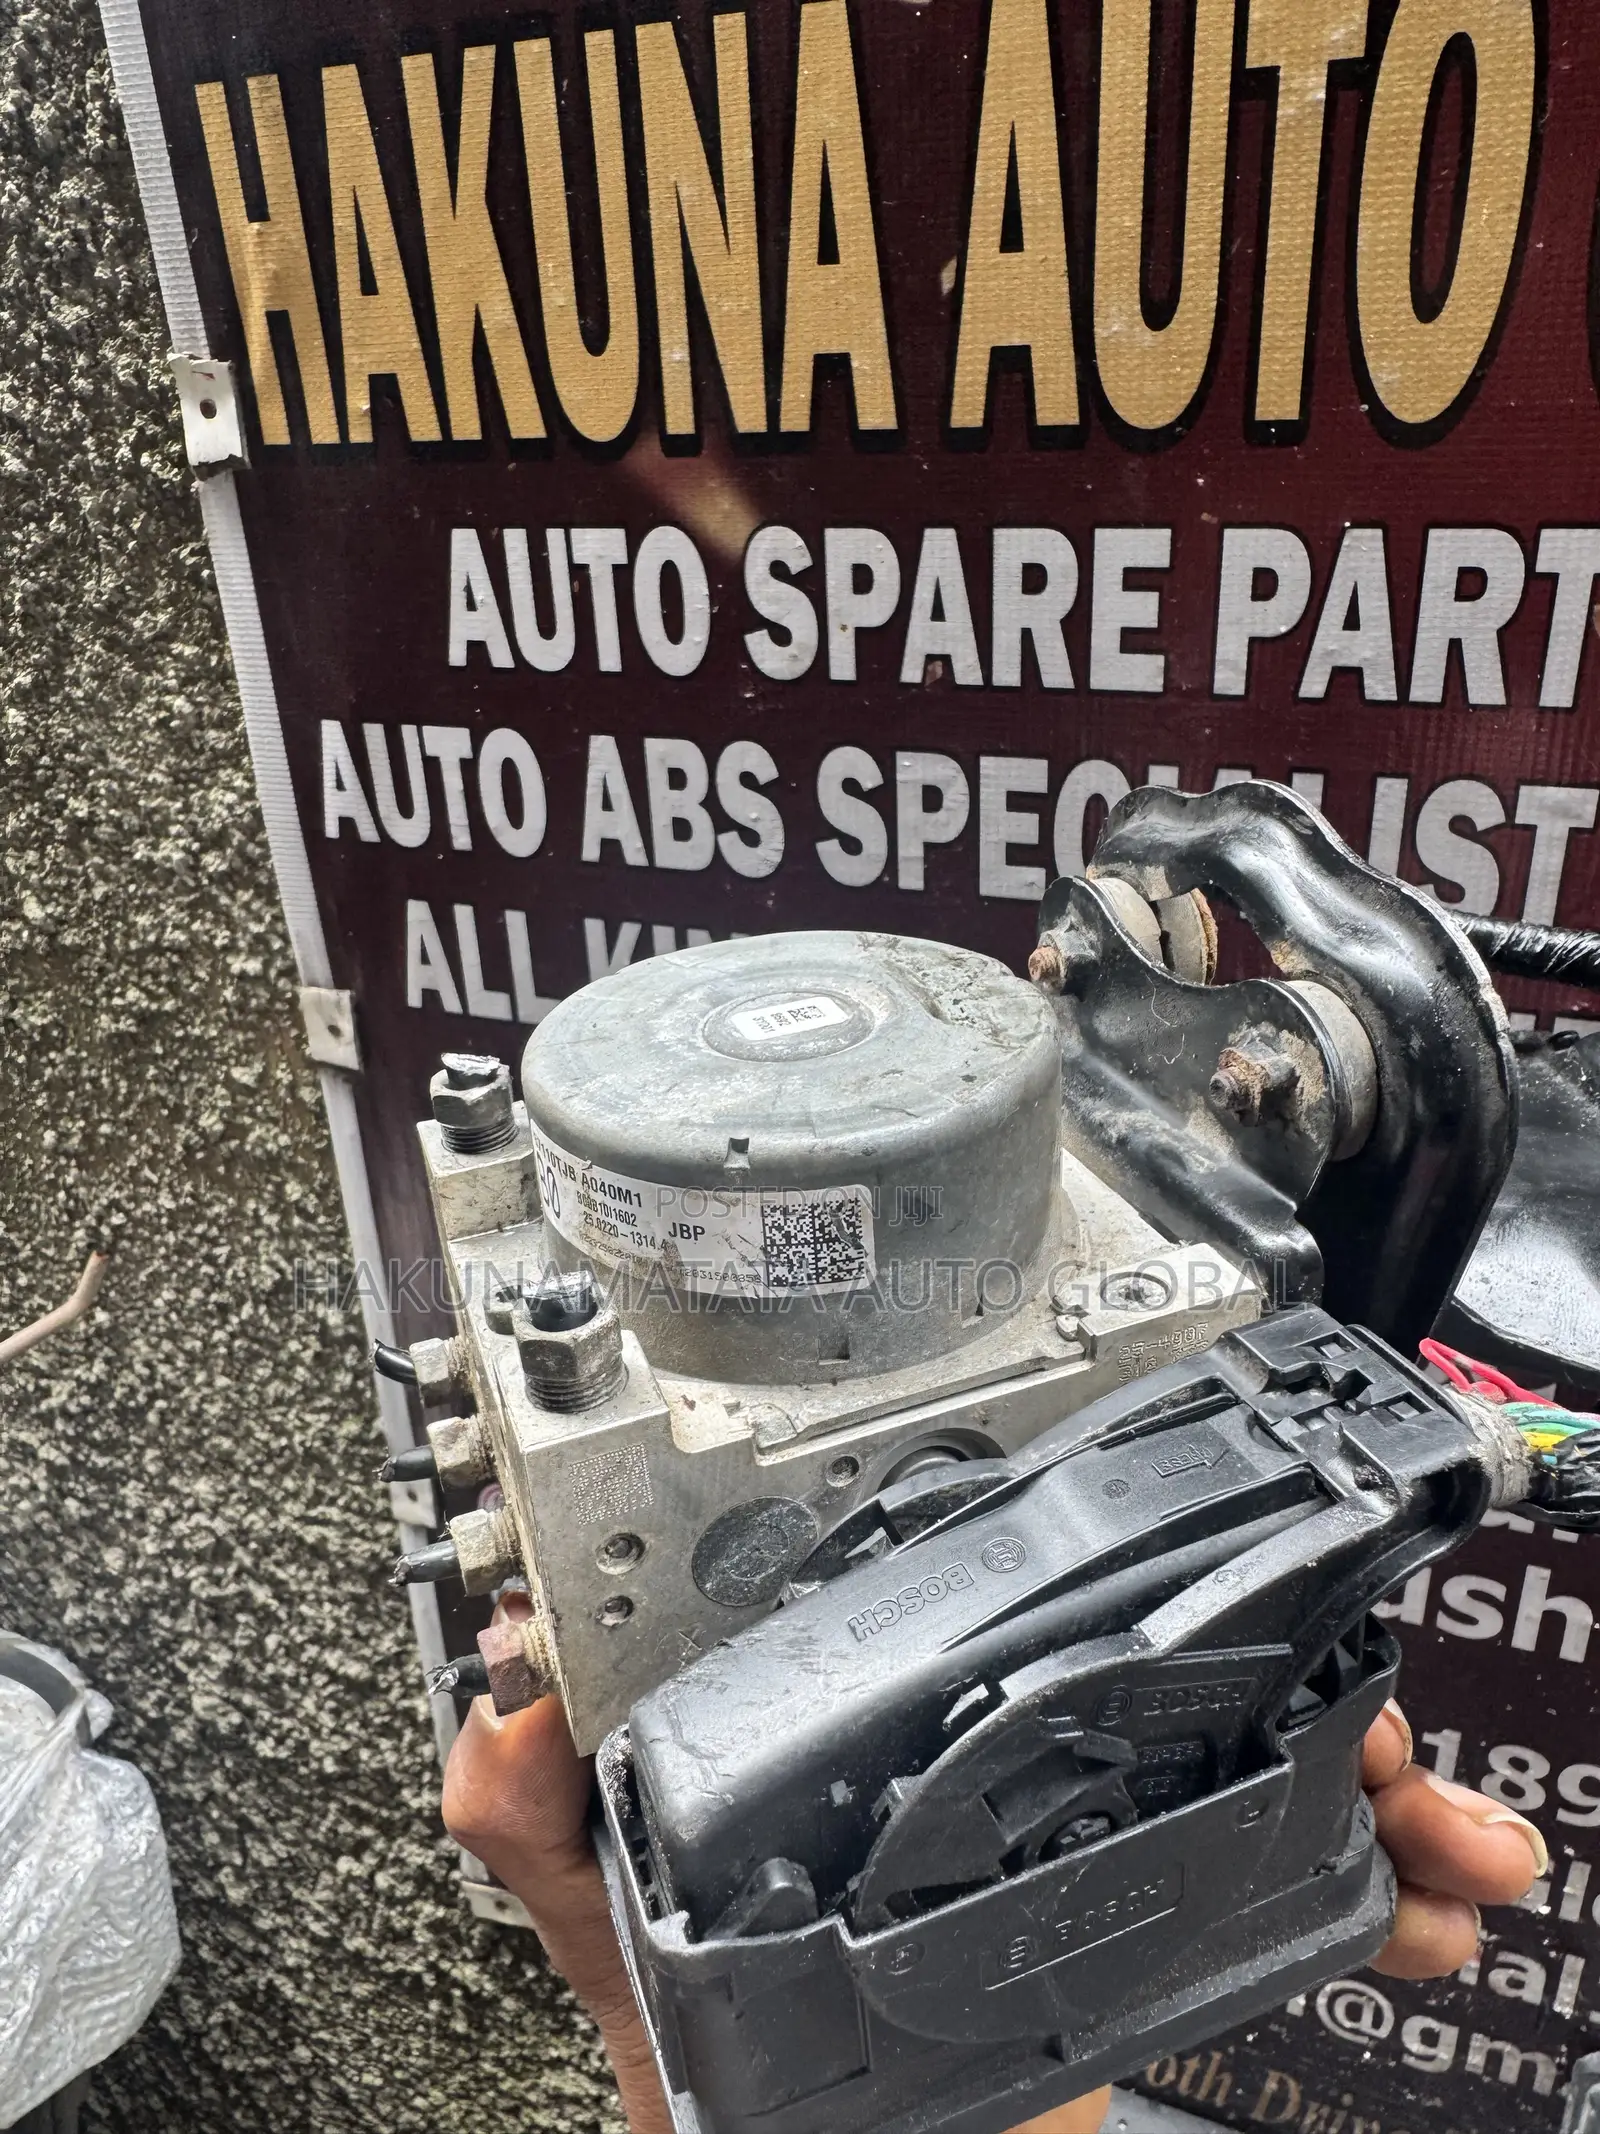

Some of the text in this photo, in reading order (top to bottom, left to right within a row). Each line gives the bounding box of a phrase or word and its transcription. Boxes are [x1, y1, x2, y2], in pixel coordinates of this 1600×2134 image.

[194, 0, 1535, 445] HAKUNA AUTO
[448, 526, 711, 676] AUTO
[743, 526, 1172, 693] SPARE
[321, 719, 1599, 924] AUTO ABS SPECIST
[407, 898, 561, 1024] ALL
[582, 1173, 642, 1207] A040M1
[668, 1222, 706, 1241] JBP
[847, 1562, 975, 1643] BOSCH
